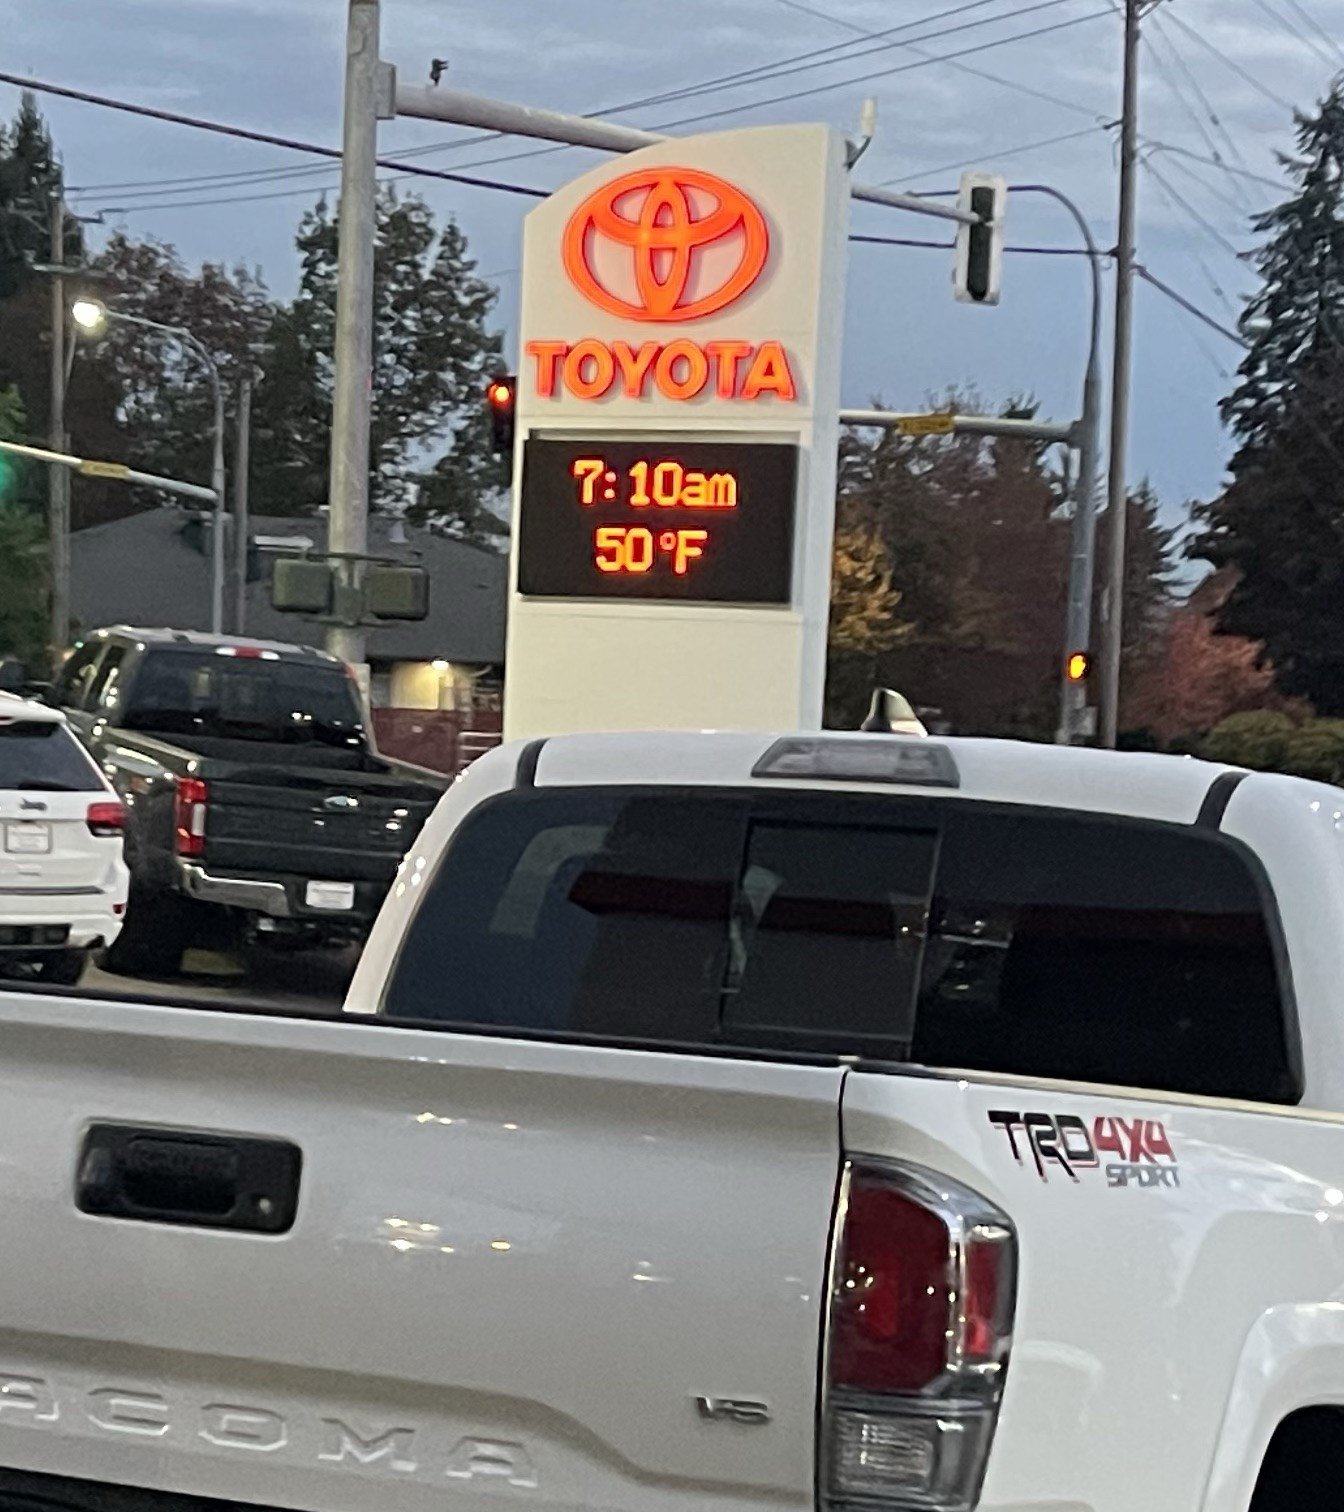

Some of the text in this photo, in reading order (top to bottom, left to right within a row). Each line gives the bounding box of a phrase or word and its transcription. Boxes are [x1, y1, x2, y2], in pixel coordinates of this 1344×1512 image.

[525, 338, 796, 401] TOYOTA
[573, 458, 738, 508] 7:10am
[594, 526, 709, 575] 50°F
[987, 1110, 1100, 1183] TRD
[1106, 1163, 1181, 1188] SPORT
[695, 1396, 771, 1425] V6
